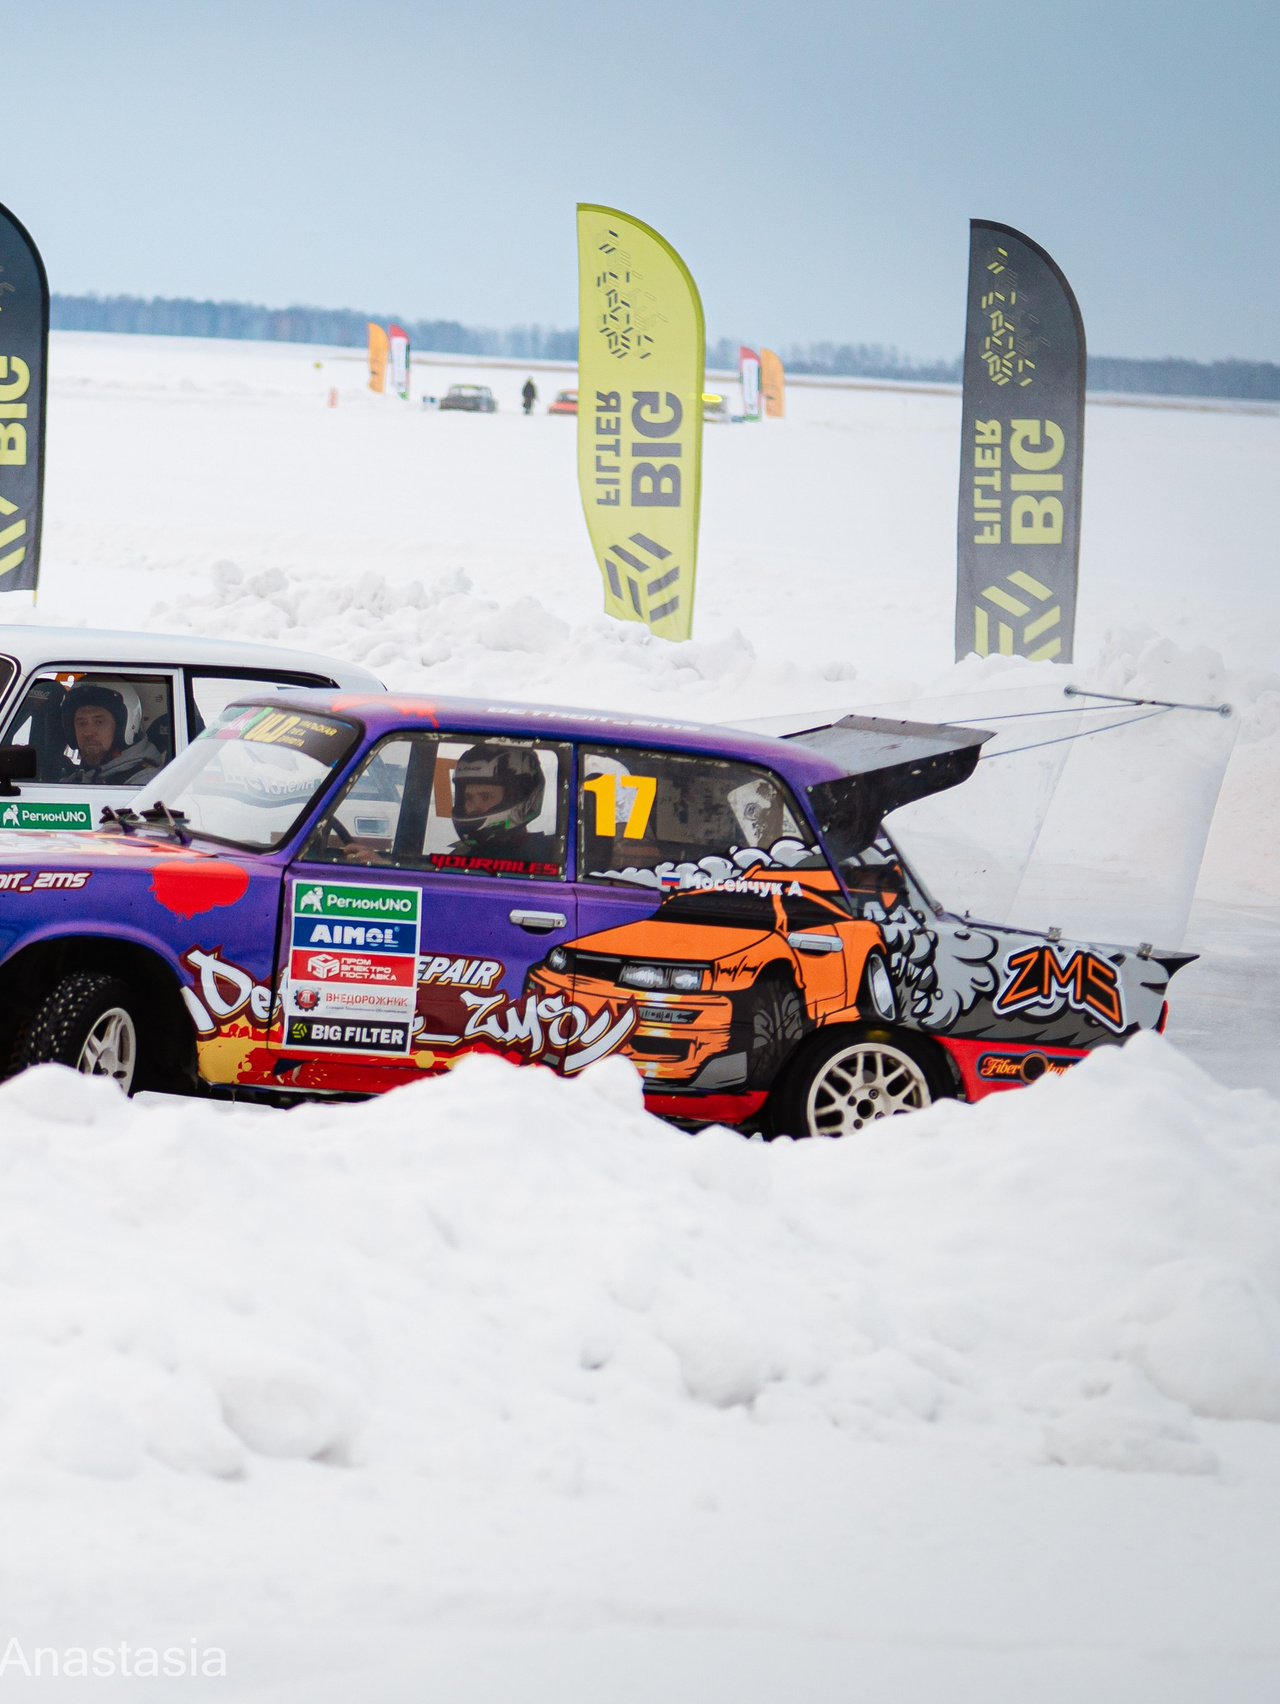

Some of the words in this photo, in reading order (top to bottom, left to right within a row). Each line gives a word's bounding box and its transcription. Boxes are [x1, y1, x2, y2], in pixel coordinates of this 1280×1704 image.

[583, 774, 657, 840] 17
[686, 873, 783, 898] Мосейчук
[340, 957, 372, 966] ПРОМ
[340, 964, 392, 974] ЭЛЕКТРО
[418, 955, 501, 988] EPAIR
[339, 971, 398, 981] ПОСТАВКА
[998, 946, 1123, 1028] ZMS
[325, 992, 409, 1007] ВНЕДОРОЖНИК
[311, 1024, 342, 1041] BIG
[344, 1026, 405, 1045] FILTER
[980, 1056, 1021, 1076] Fiber
